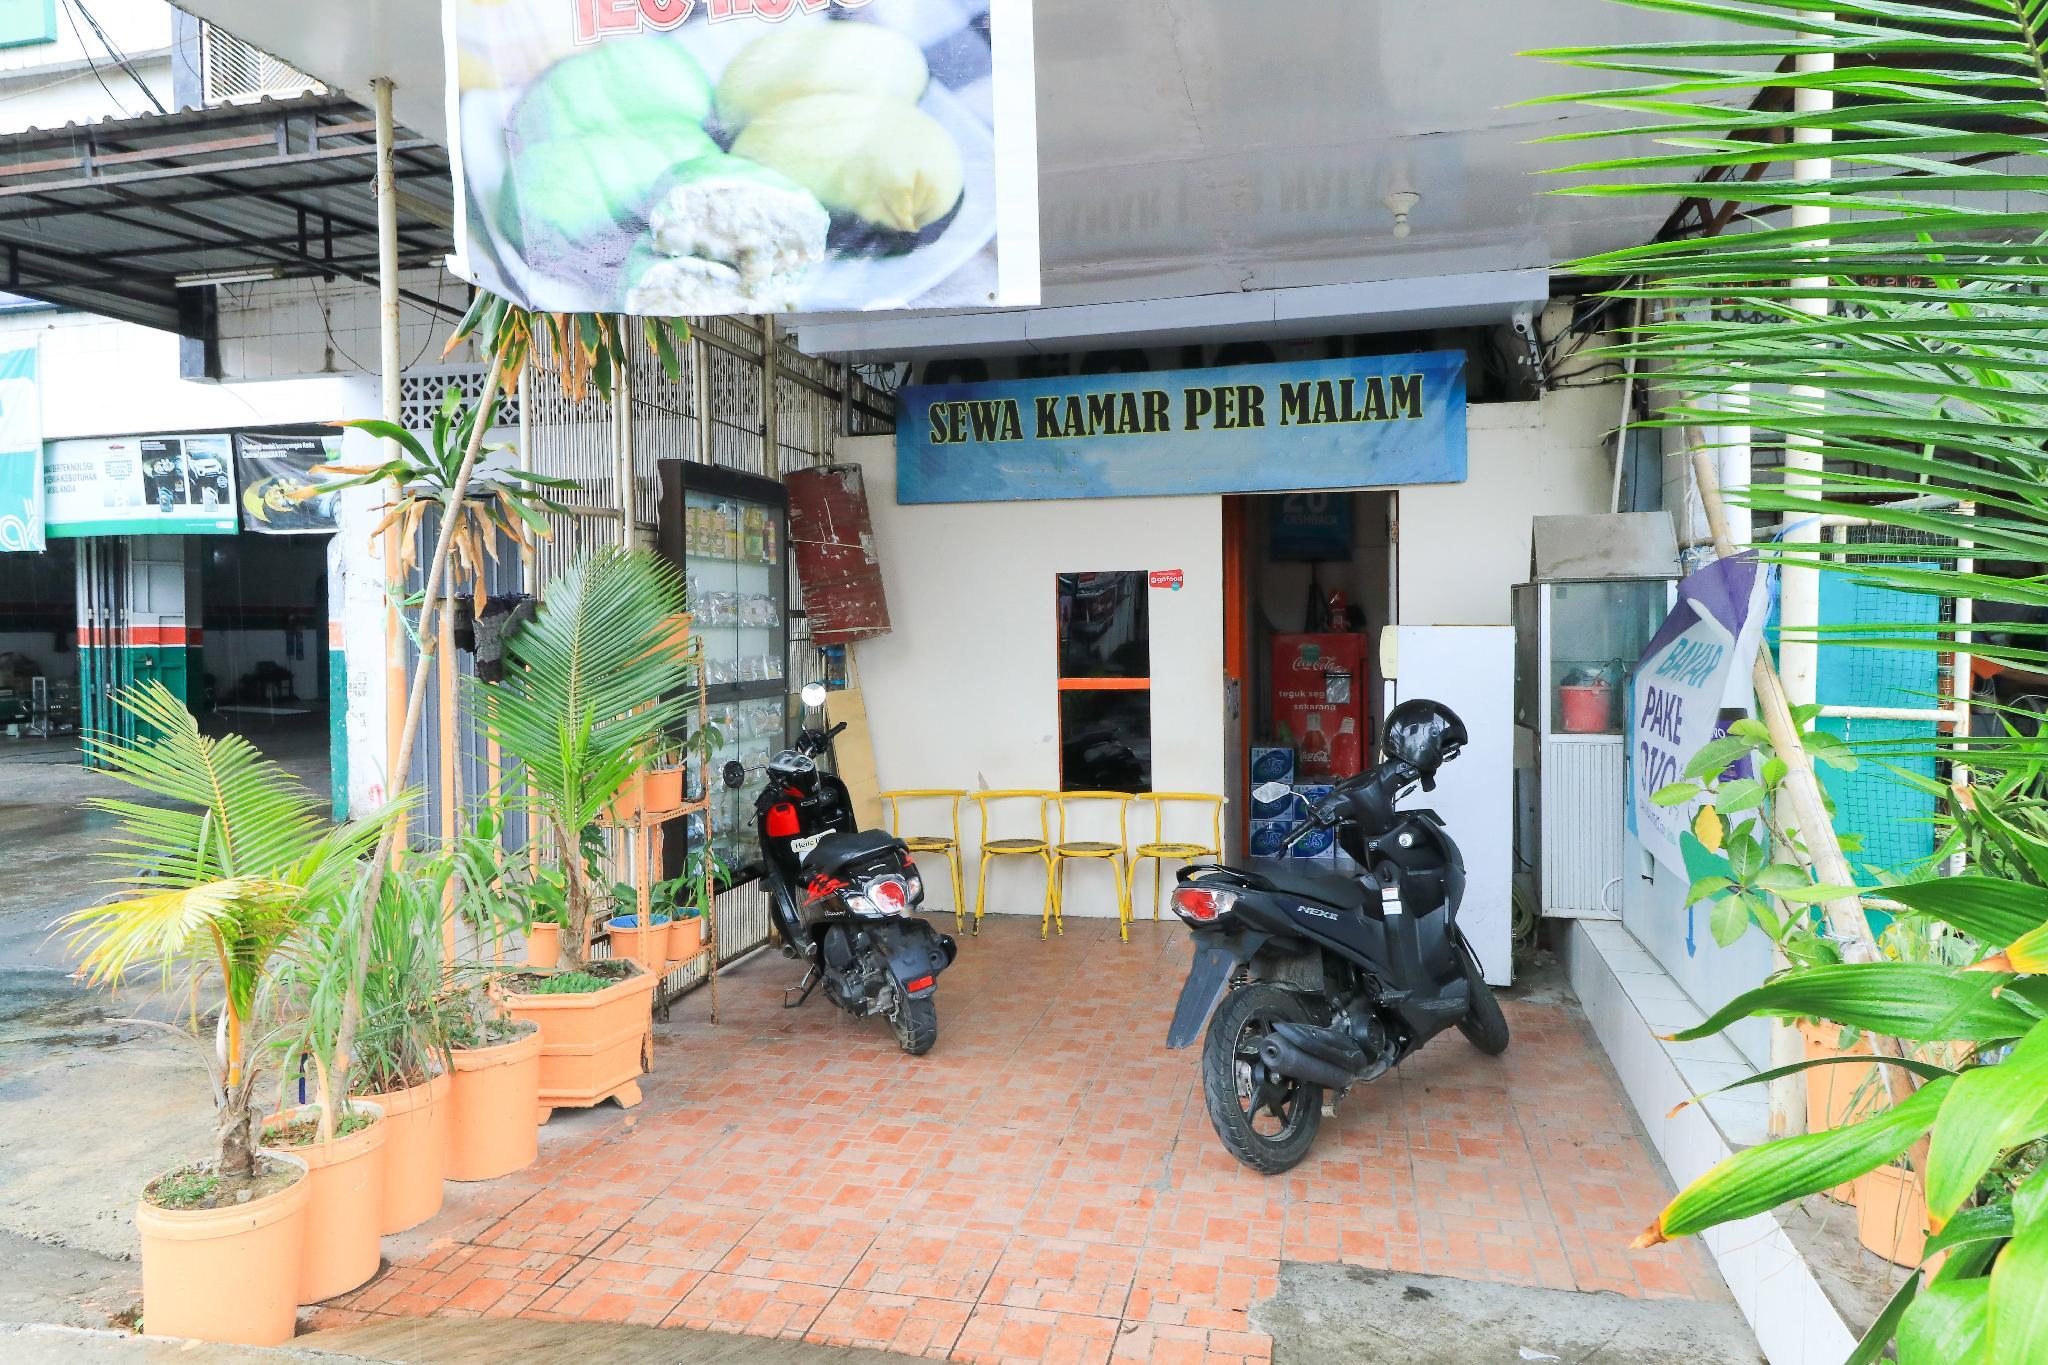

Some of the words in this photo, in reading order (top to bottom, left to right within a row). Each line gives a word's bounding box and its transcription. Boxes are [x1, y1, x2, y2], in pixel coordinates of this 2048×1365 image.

[929, 399, 1023, 444] SEWA
[1034, 389, 1170, 438] KAMAR
[1183, 384, 1265, 430] PER
[1279, 373, 1424, 426] MALAM
[1279, 689, 1306, 699] teguk
[1293, 703, 1337, 712] sekarang
[1640, 685, 1682, 745] PAKE
